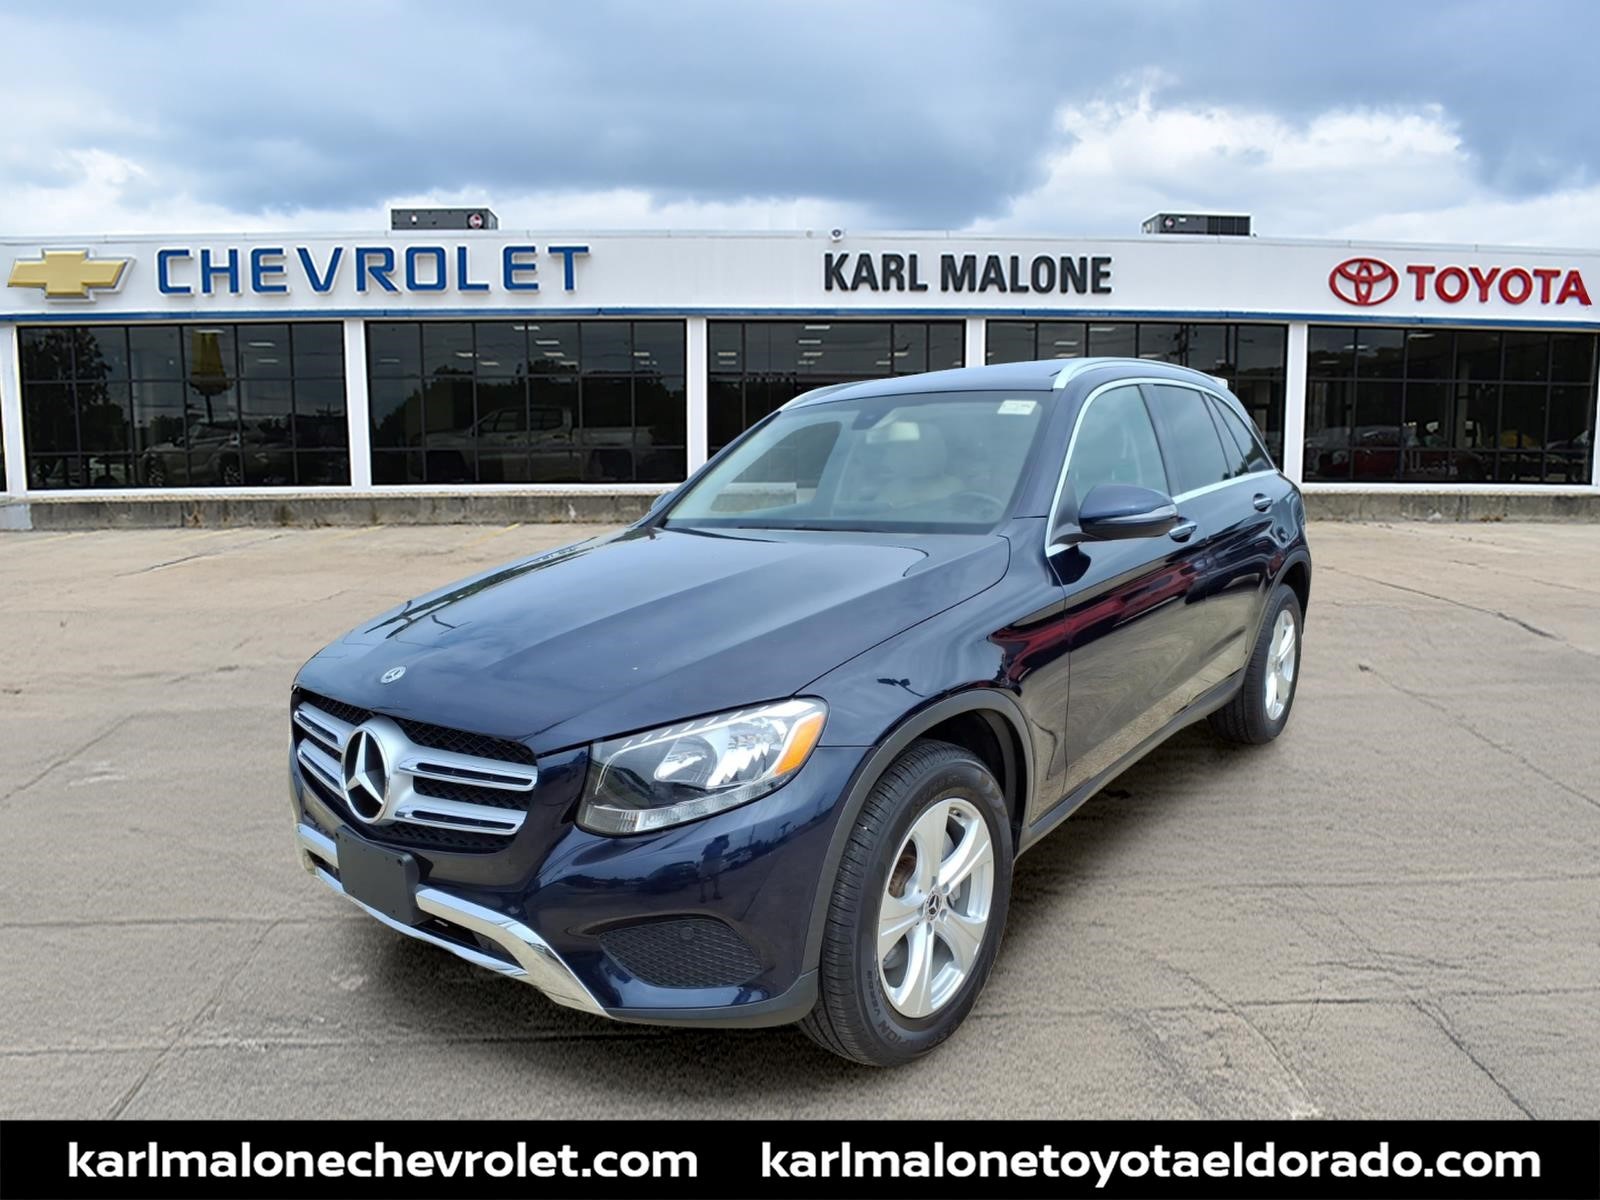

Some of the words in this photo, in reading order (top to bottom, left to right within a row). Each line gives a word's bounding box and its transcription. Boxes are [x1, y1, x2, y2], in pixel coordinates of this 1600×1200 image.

[158, 247, 589, 295] CHEVROLET
[824, 253, 929, 292] KARL
[940, 254, 1112, 295] MALONE
[1407, 265, 1592, 306] TOYOTA
